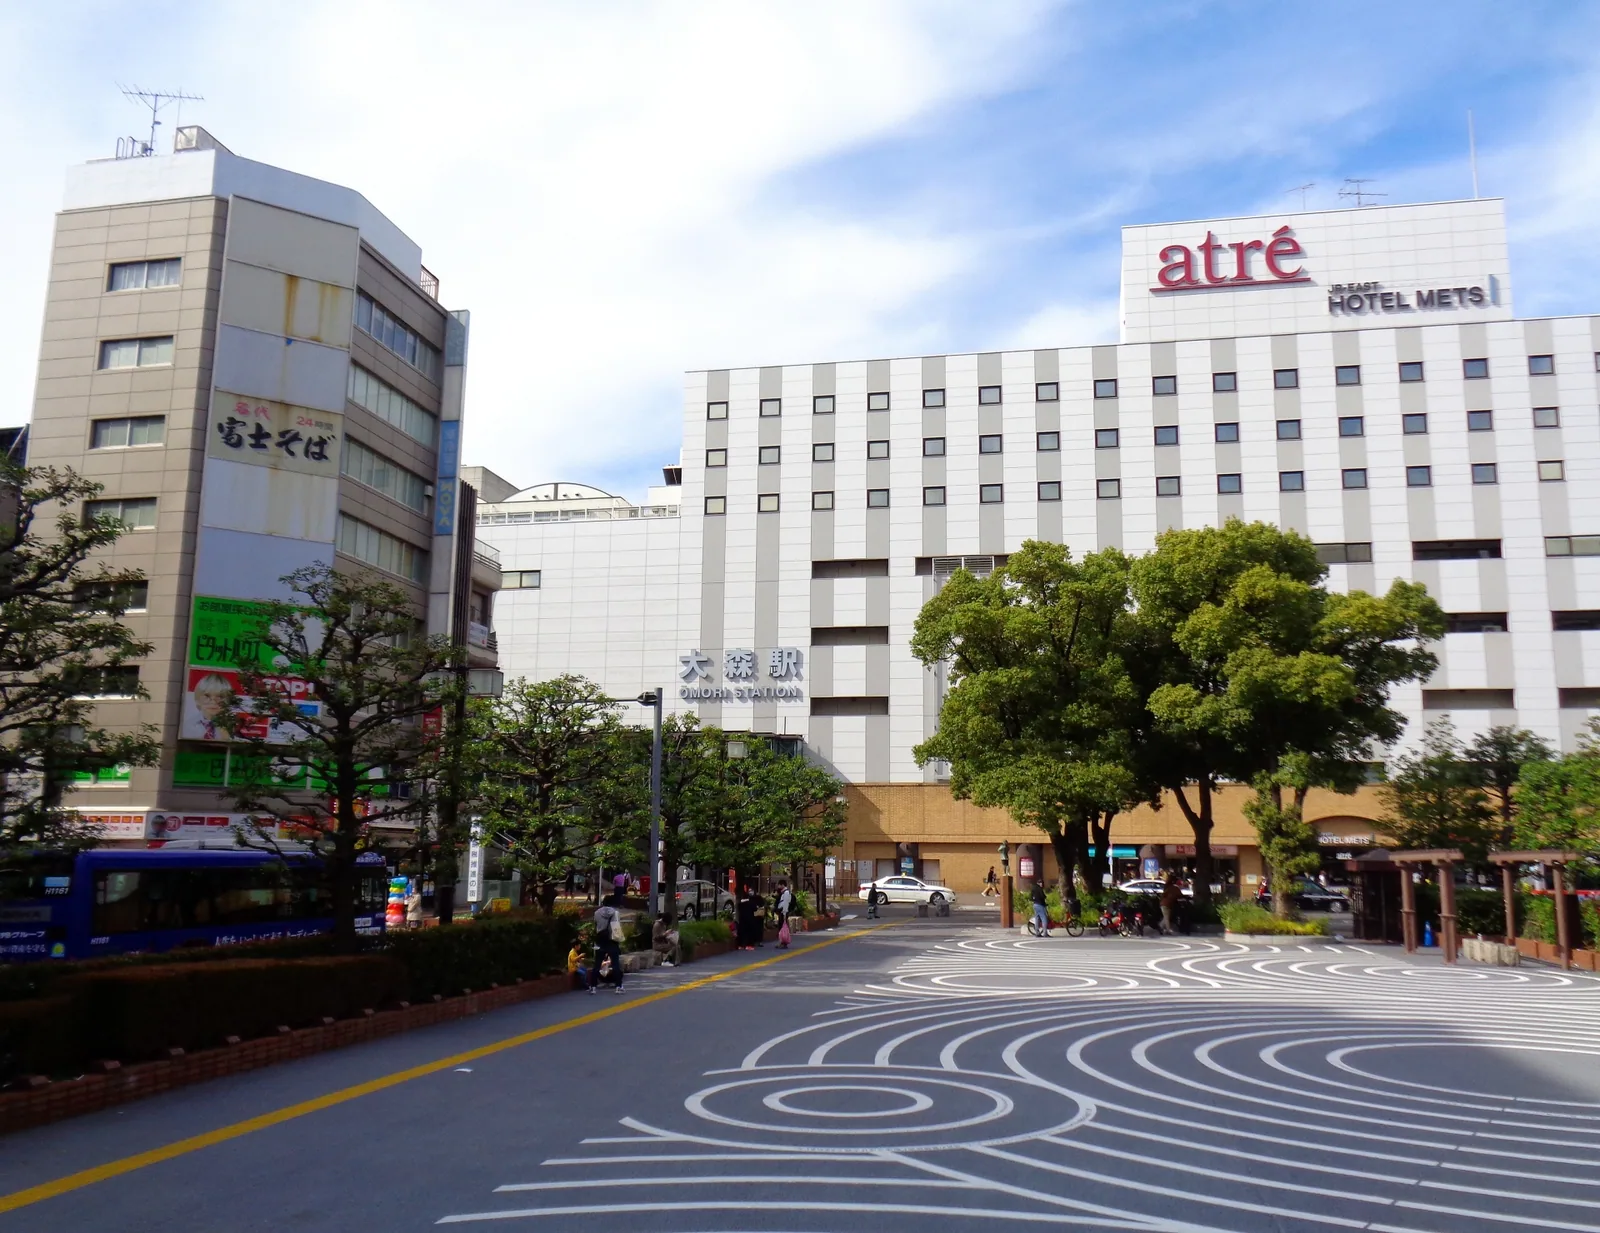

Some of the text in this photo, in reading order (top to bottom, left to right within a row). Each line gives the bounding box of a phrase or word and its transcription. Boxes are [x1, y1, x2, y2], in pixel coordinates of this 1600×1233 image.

[1158, 225, 1303, 287] atré
[1328, 281, 1380, 294] JR-EAST
[1328, 286, 1485, 313] HOTEL METS
[233, 402, 271, 420] 名代
[297, 415, 334, 432] 24時間
[217, 416, 338, 462] 富士そば
[439, 482, 453, 526] NOVA
[679, 648, 798, 679] 大森駅
[734, 686, 798, 699] STATION
